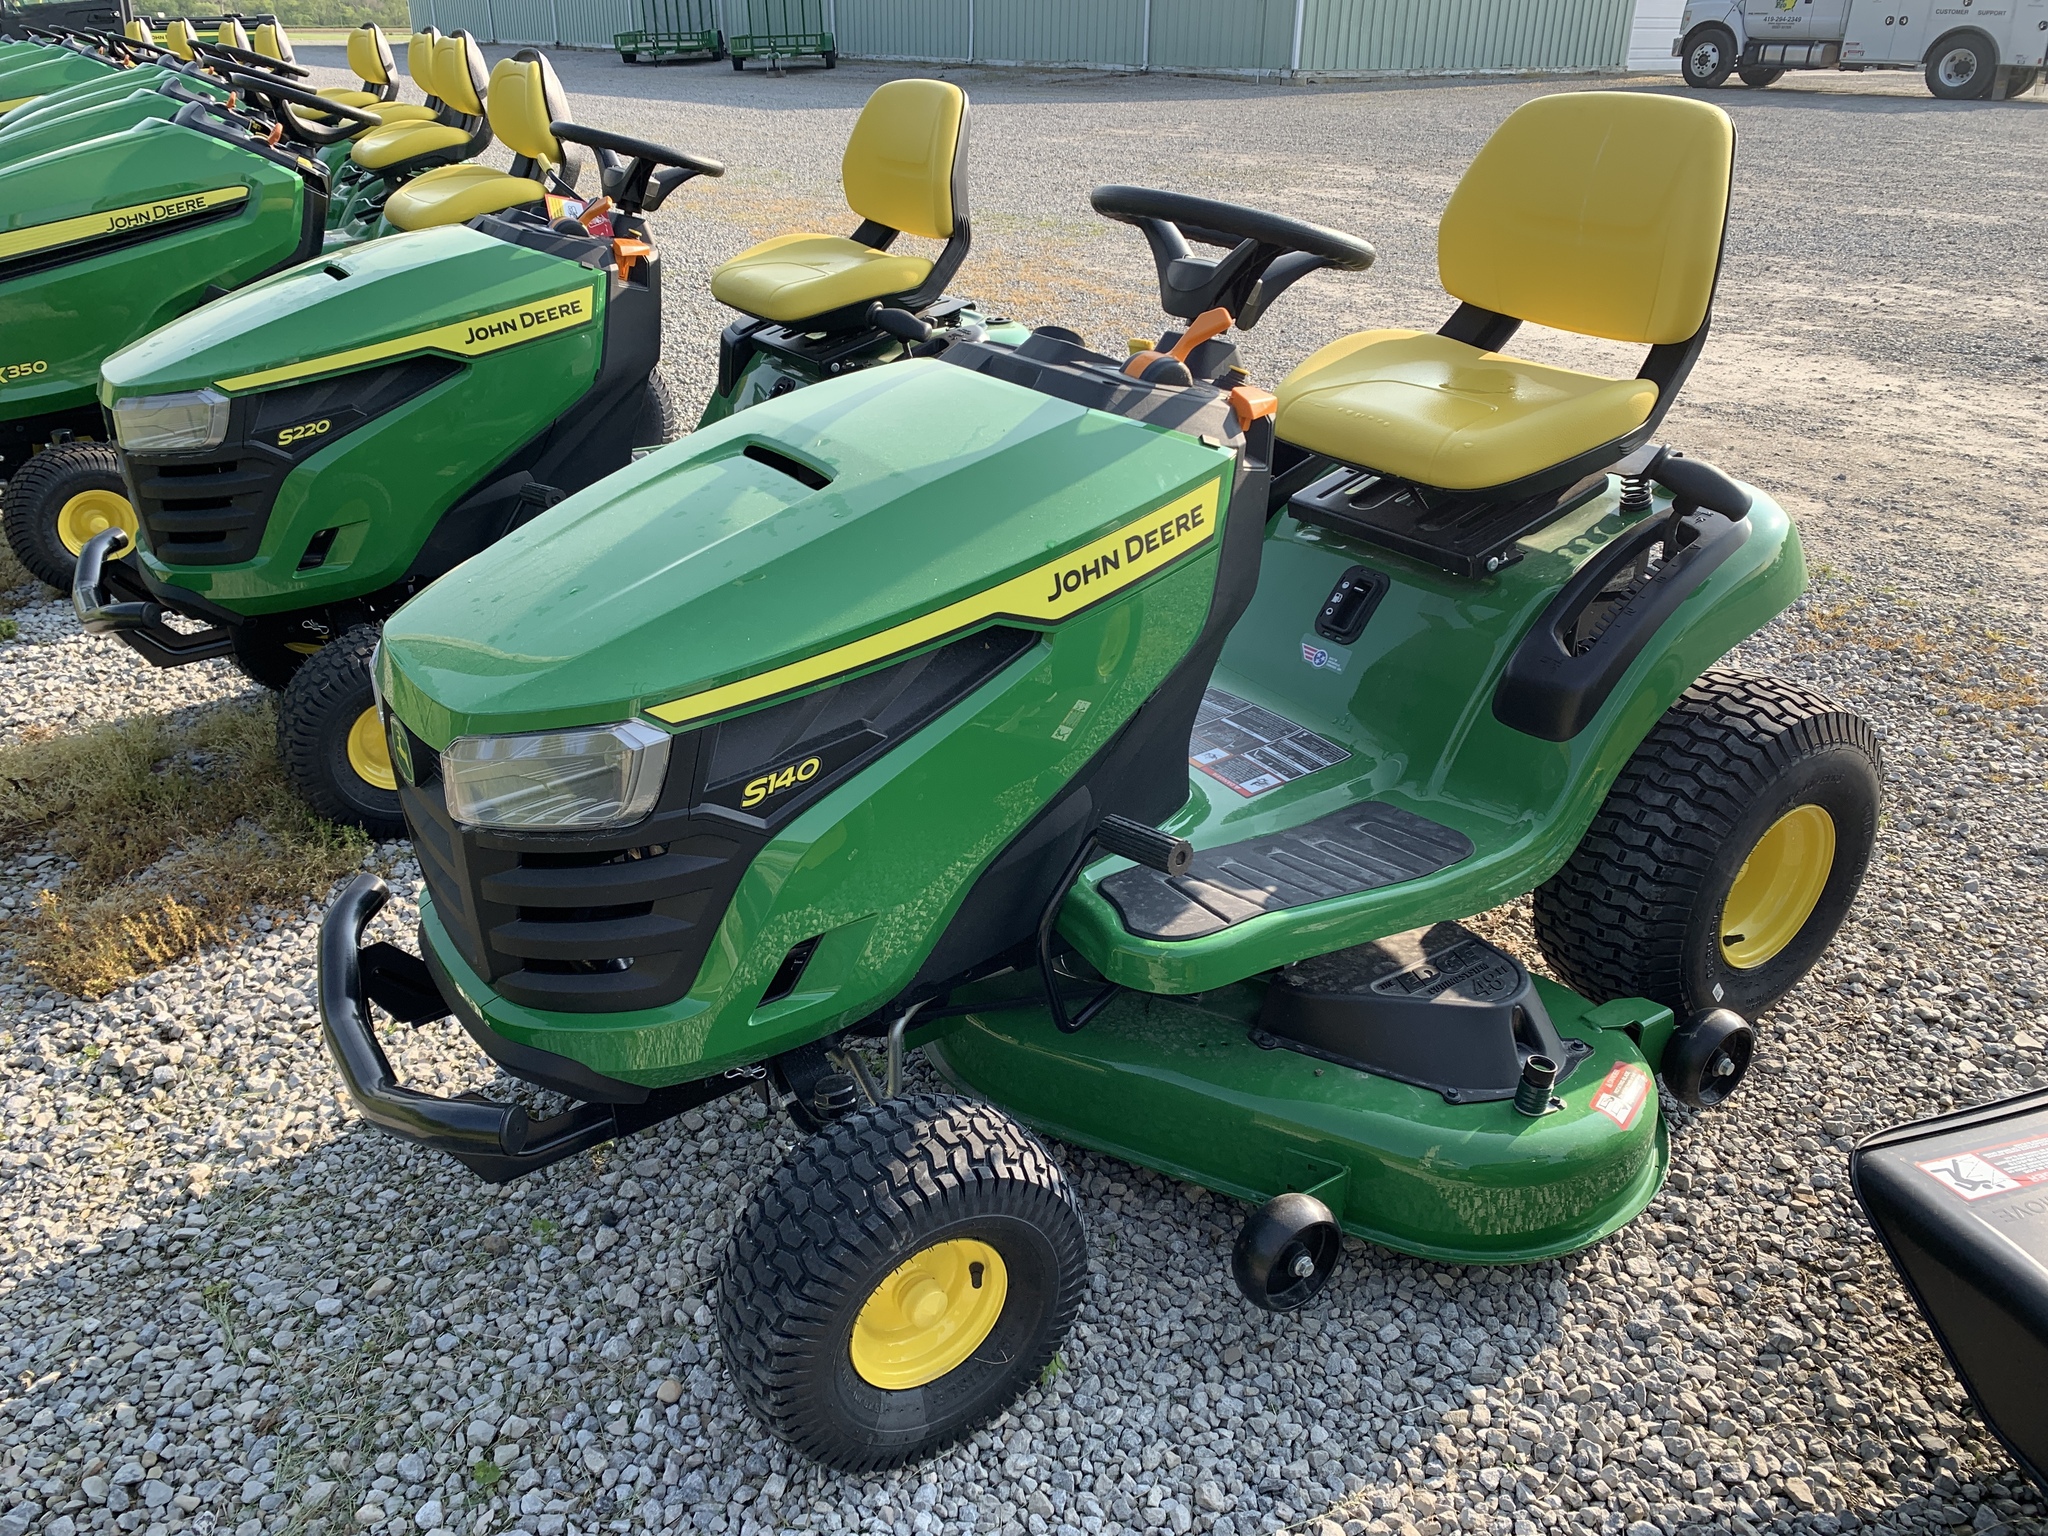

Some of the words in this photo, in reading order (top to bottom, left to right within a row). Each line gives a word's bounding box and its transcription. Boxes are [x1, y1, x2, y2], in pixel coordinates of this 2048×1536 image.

[106, 210, 151, 232] JOHN
[153, 196, 206, 219] DEERE
[464, 318, 518, 345] JOHN
[519, 300, 583, 329] DEERE
[278, 419, 331, 446] S220
[1047, 549, 1120, 602] JOHN
[1125, 503, 1205, 564] DEERE
[741, 757, 820, 807] S140
[1378, 978, 1395, 991] THE
[1396, 946, 1482, 994] EDGE
